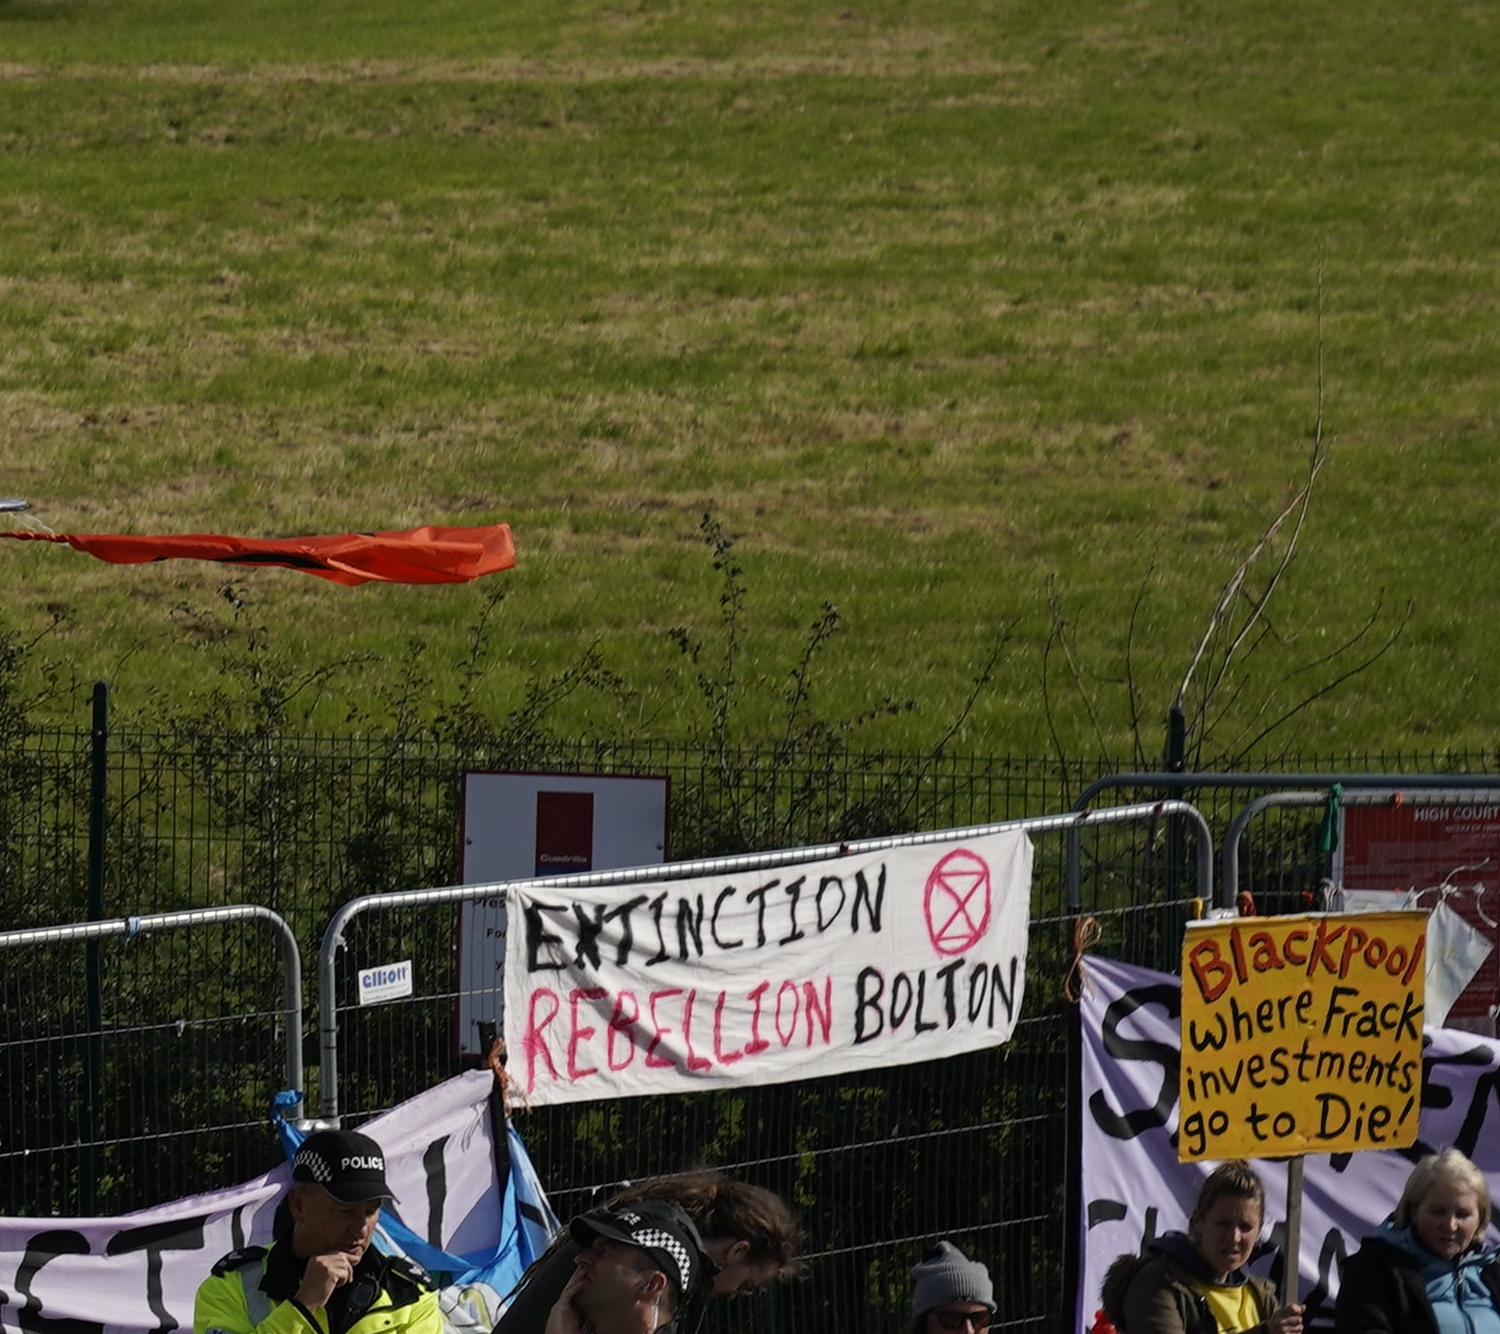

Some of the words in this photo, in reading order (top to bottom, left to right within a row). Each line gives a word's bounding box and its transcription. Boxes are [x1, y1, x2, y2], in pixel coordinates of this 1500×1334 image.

[524, 864, 886, 973] EXTINCTION
[1189, 919, 1425, 1004] Blackpool
[522, 976, 833, 1094] REBELLION
[854, 957, 1018, 1045] BOLTON
[1190, 988, 1313, 1052] where
[1322, 986, 1424, 1043] Frack
[1186, 1038, 1416, 1102] investments
[1184, 1108, 1229, 1156] go
[1245, 1103, 1296, 1141] to
[1316, 1092, 1414, 1143] Die!
